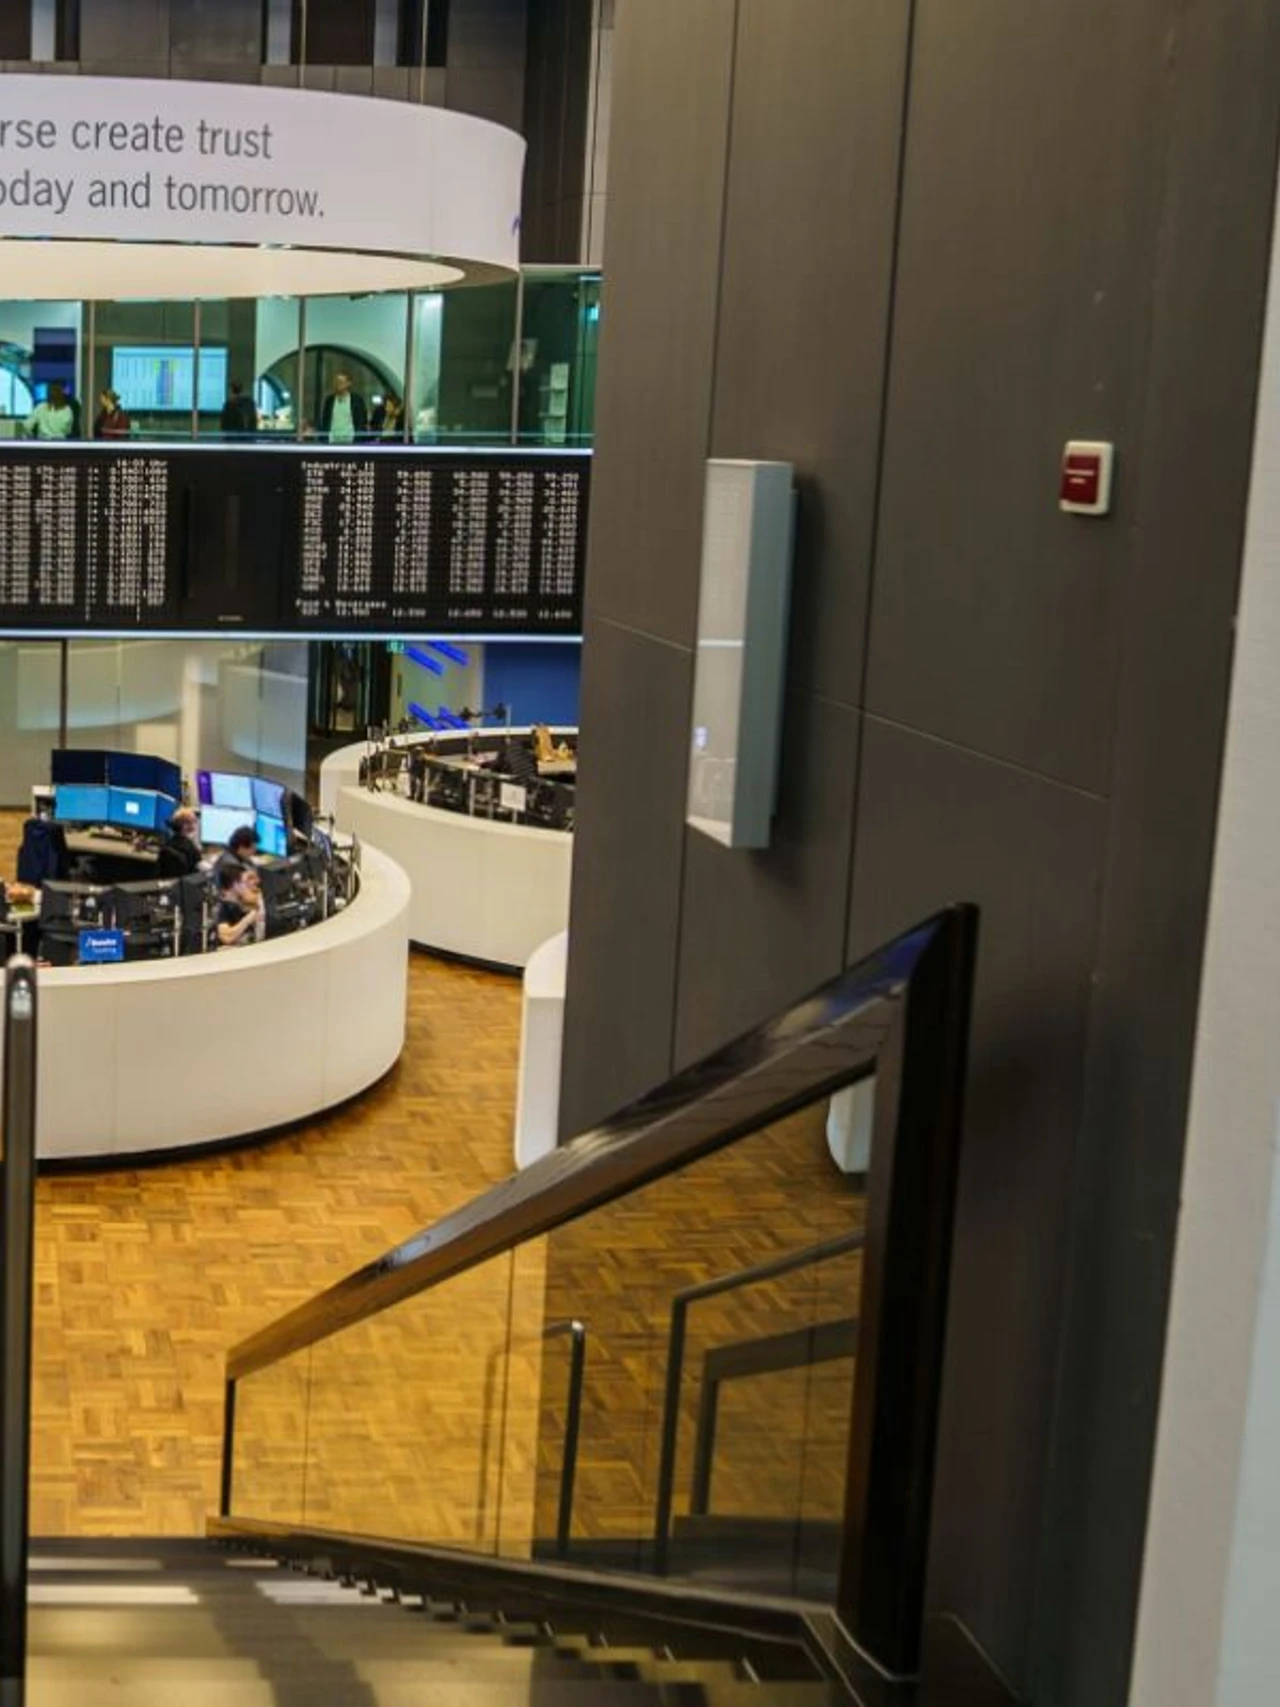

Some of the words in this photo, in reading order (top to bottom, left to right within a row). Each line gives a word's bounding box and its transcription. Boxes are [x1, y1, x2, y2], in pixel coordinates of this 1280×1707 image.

[71, 115, 185, 154] create
[196, 119, 273, 160] trust
[87, 171, 151, 210] and
[163, 174, 325, 218] tomorrow.
